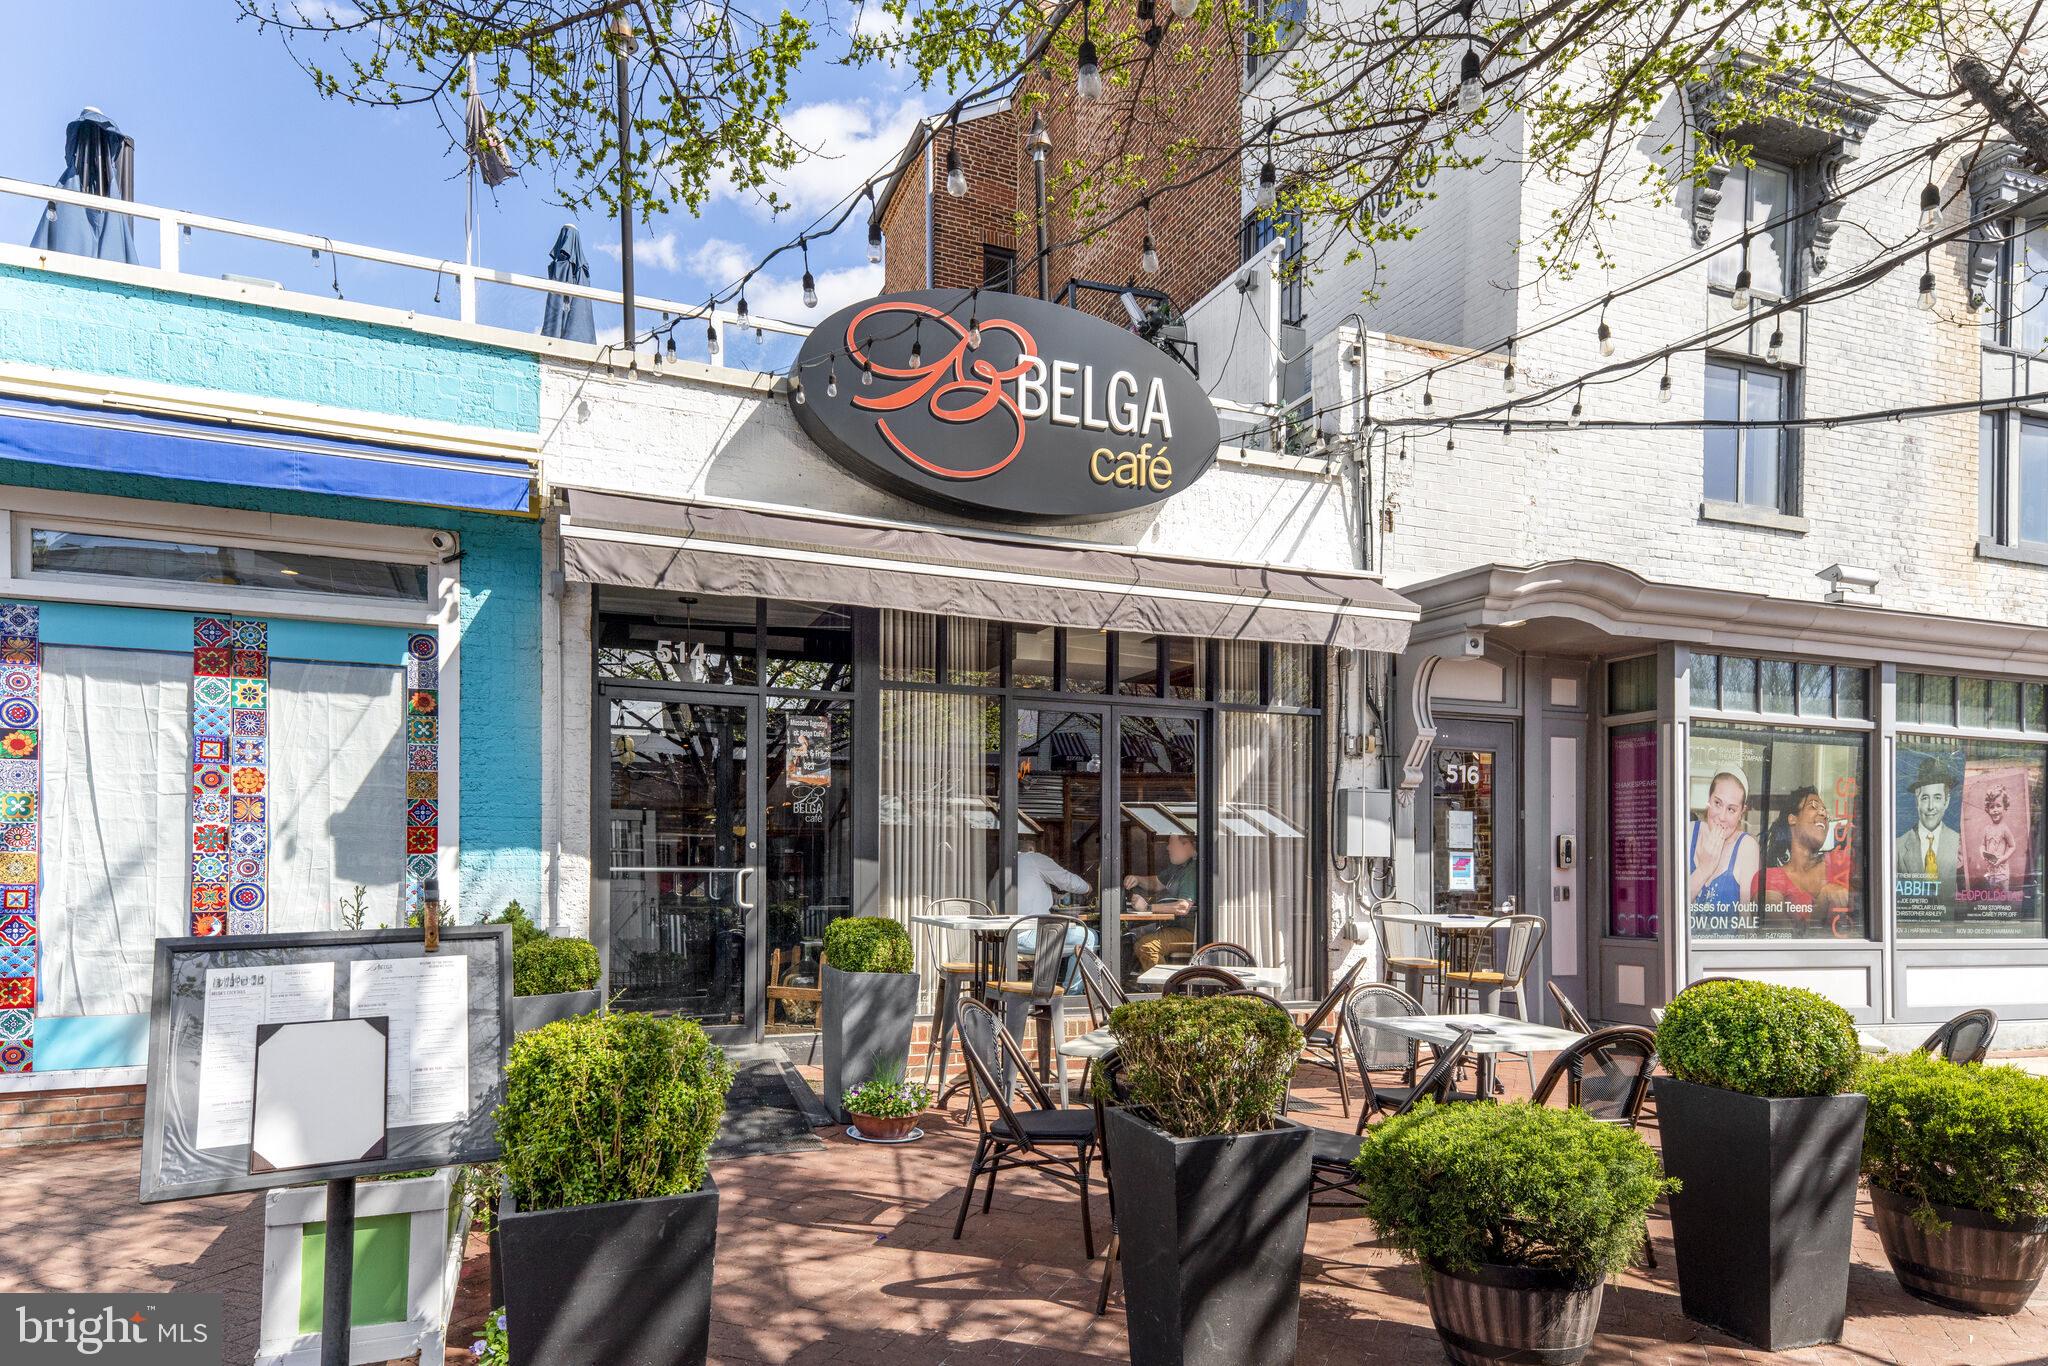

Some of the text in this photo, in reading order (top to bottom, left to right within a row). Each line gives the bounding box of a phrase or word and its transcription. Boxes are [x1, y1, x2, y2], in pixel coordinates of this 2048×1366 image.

[1018, 354, 1172, 439] BELGA
[1090, 442, 1172, 491] café
[656, 640, 707, 664] 514
[1446, 764, 1480, 785] 516
[793, 802, 823, 814] BELGA
[1896, 880, 1941, 896] ABBITT
[1690, 901, 1813, 913] asses for Youth and Teens
[1690, 916, 1759, 929] OW ON SALE
